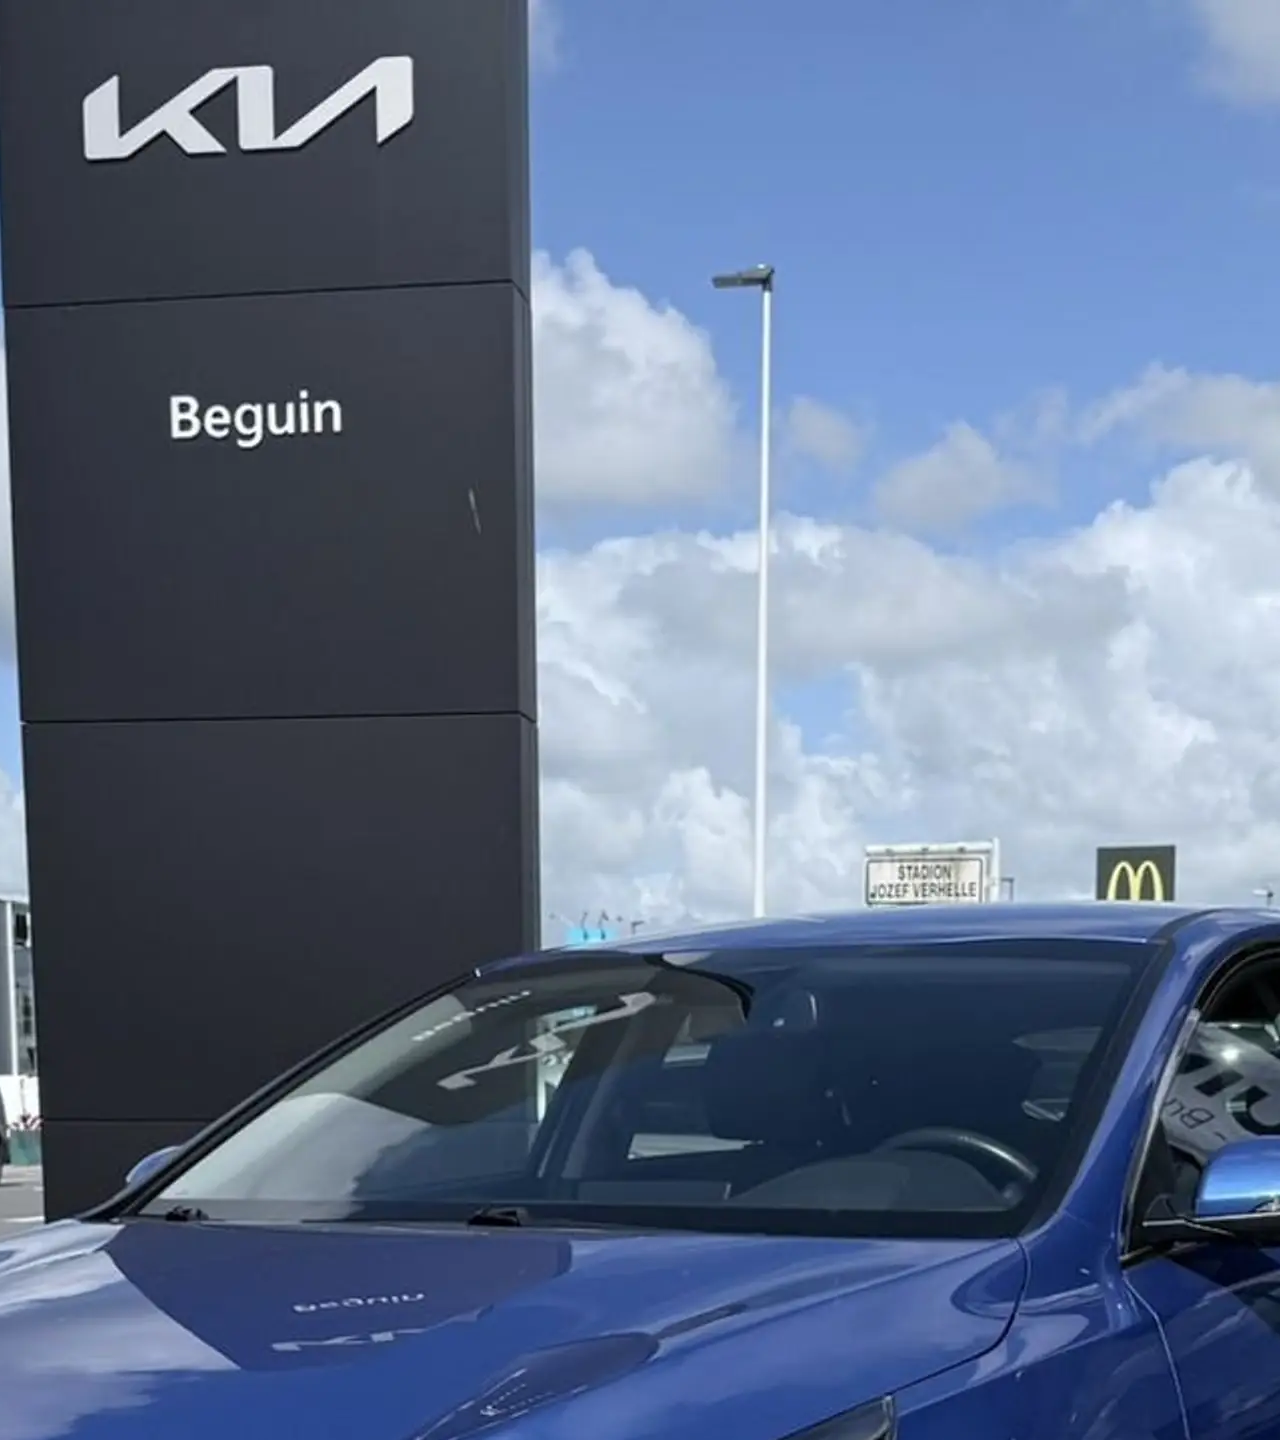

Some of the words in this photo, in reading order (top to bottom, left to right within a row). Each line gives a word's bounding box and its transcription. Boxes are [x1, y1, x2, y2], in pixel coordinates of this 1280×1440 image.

[82, 55, 414, 161] KIA
[170, 390, 342, 448] Beguin
[870, 884, 909, 899] JOZEF
[912, 882, 977, 898] VERHELLE
[897, 864, 952, 881] STADION
